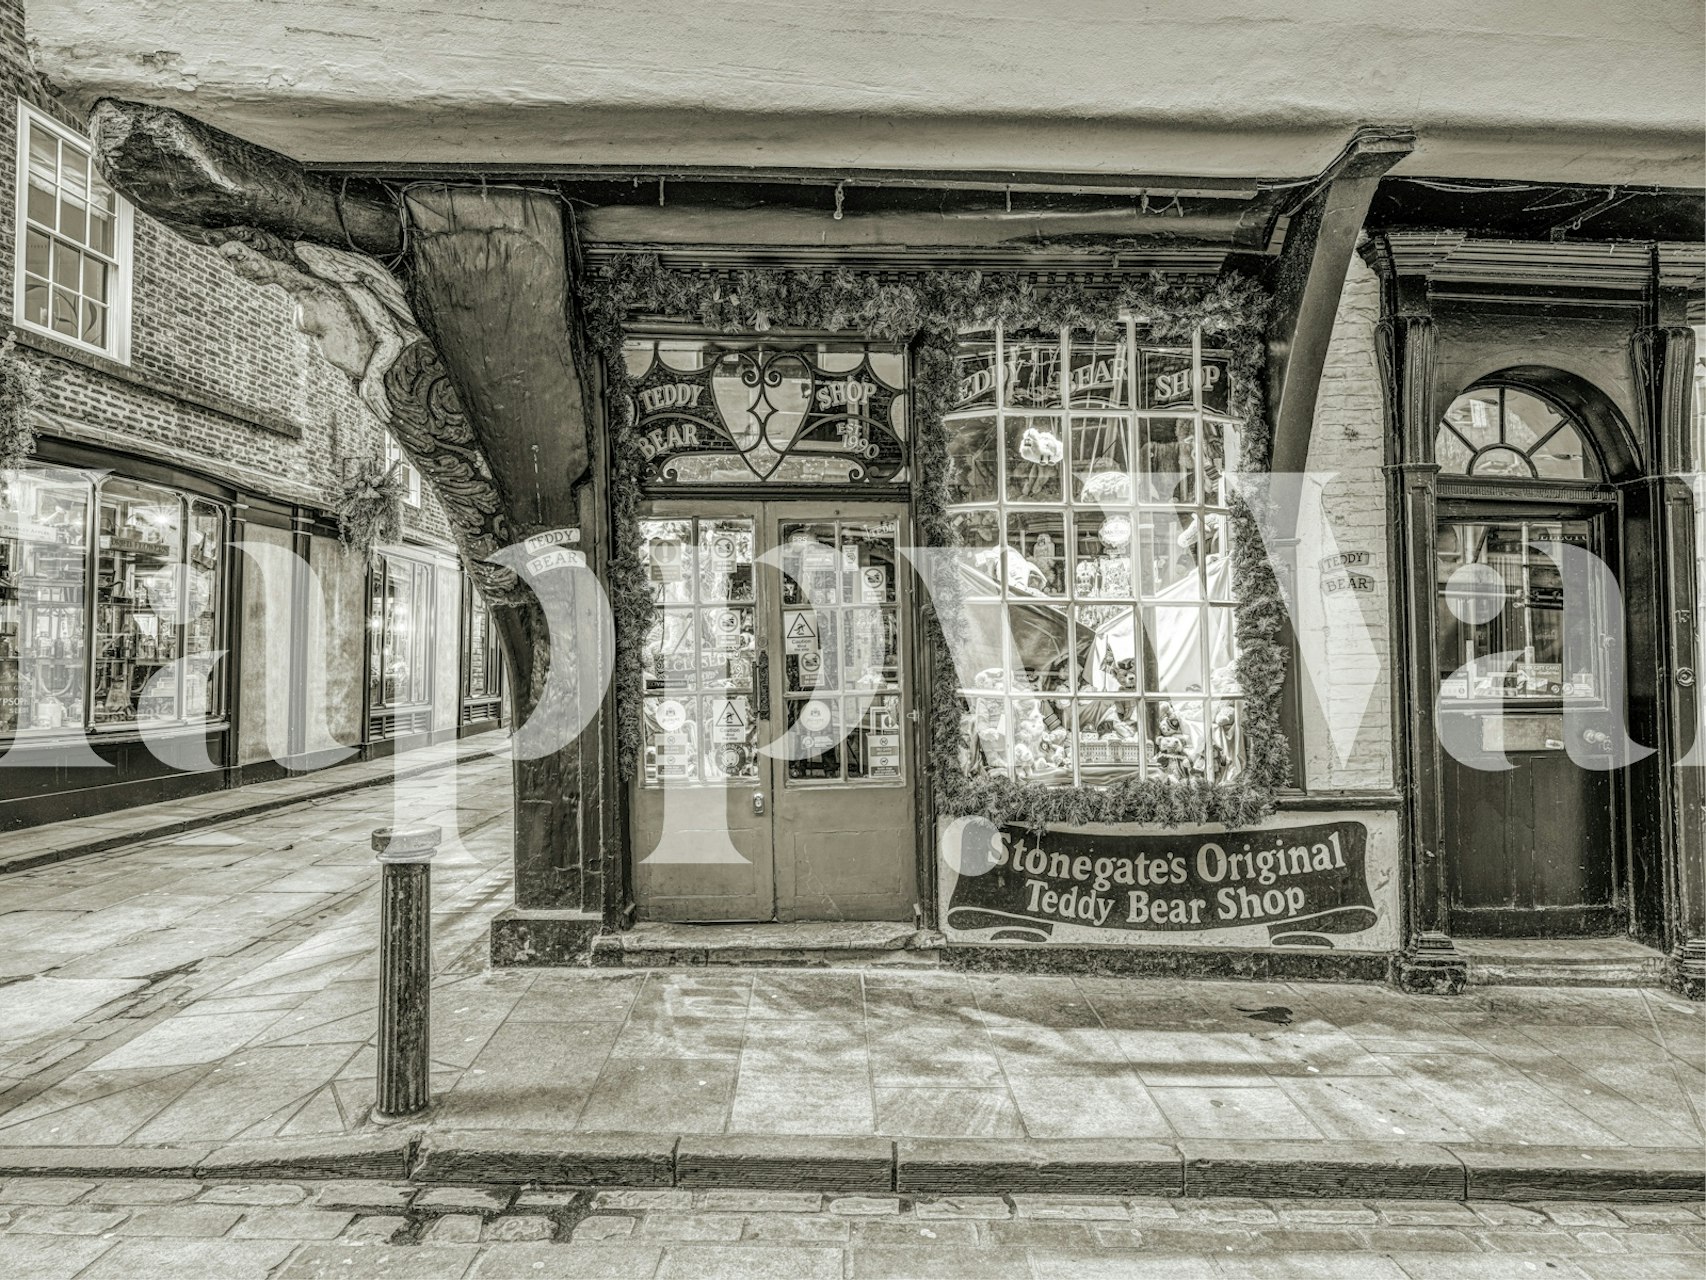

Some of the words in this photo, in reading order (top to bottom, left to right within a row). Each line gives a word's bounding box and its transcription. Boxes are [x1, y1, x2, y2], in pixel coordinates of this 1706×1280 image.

[815, 380, 878, 411] SHOP
[955, 360, 1026, 402] EDDY
[1051, 358, 1128, 394] BEAR
[639, 382, 705, 413] TEDDY
[637, 423, 700, 461] BEAR
[842, 434, 880, 459] 1990
[528, 530, 574, 550] TEDDY
[532, 551, 578, 572] BEAR
[1323, 552, 1364, 569] TEDDY
[1326, 577, 1369, 592] BEAR
[987, 831, 1188, 891] Stonegate's
[1196, 830, 1347, 885] Original
[1025, 879, 1115, 926] Teddy
[1125, 890, 1206, 924] Bear
[1216, 885, 1305, 920] Shop
